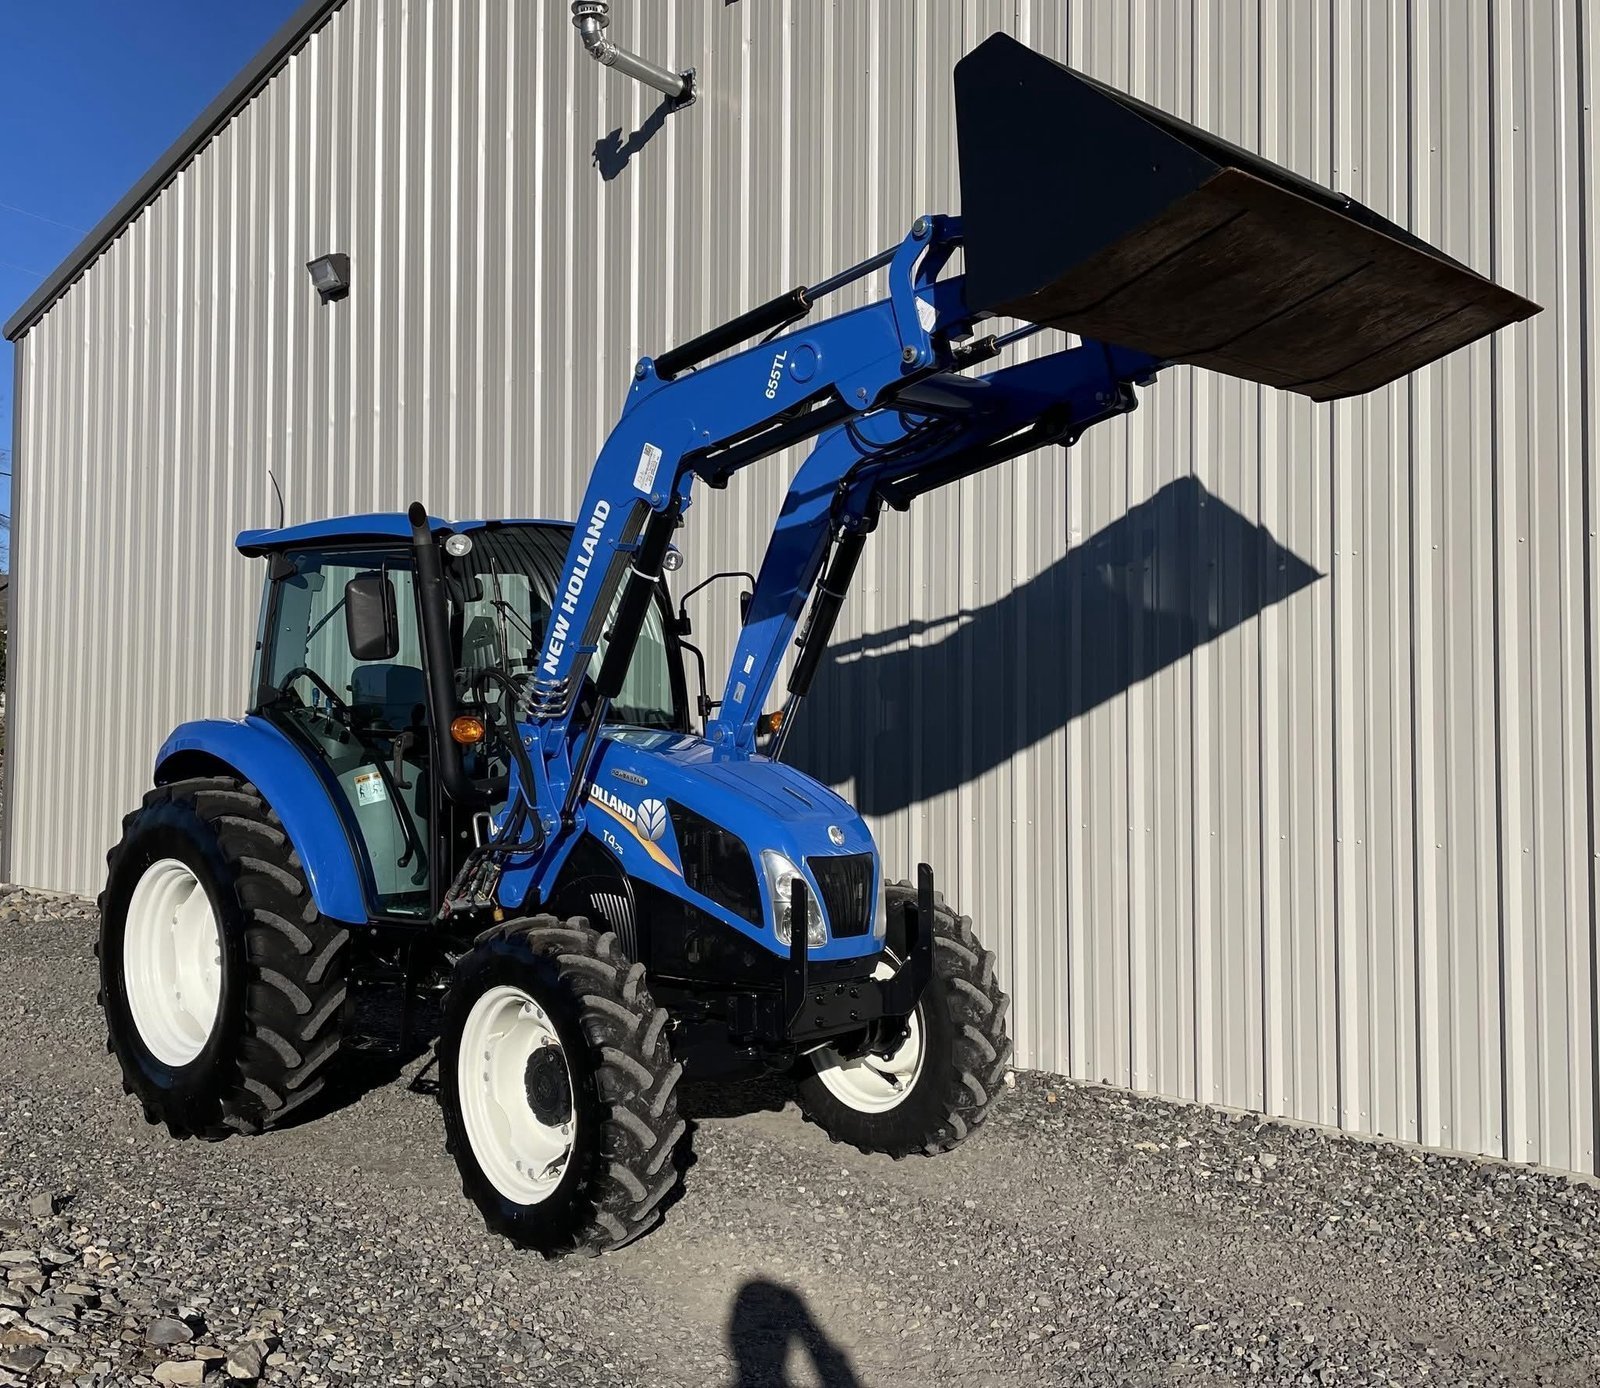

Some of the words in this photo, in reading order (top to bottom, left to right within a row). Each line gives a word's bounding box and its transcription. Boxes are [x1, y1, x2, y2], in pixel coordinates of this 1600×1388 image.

[765, 350, 788, 399] 655TL
[543, 614, 571, 675] NEW
[561, 500, 611, 615] HOLLAND
